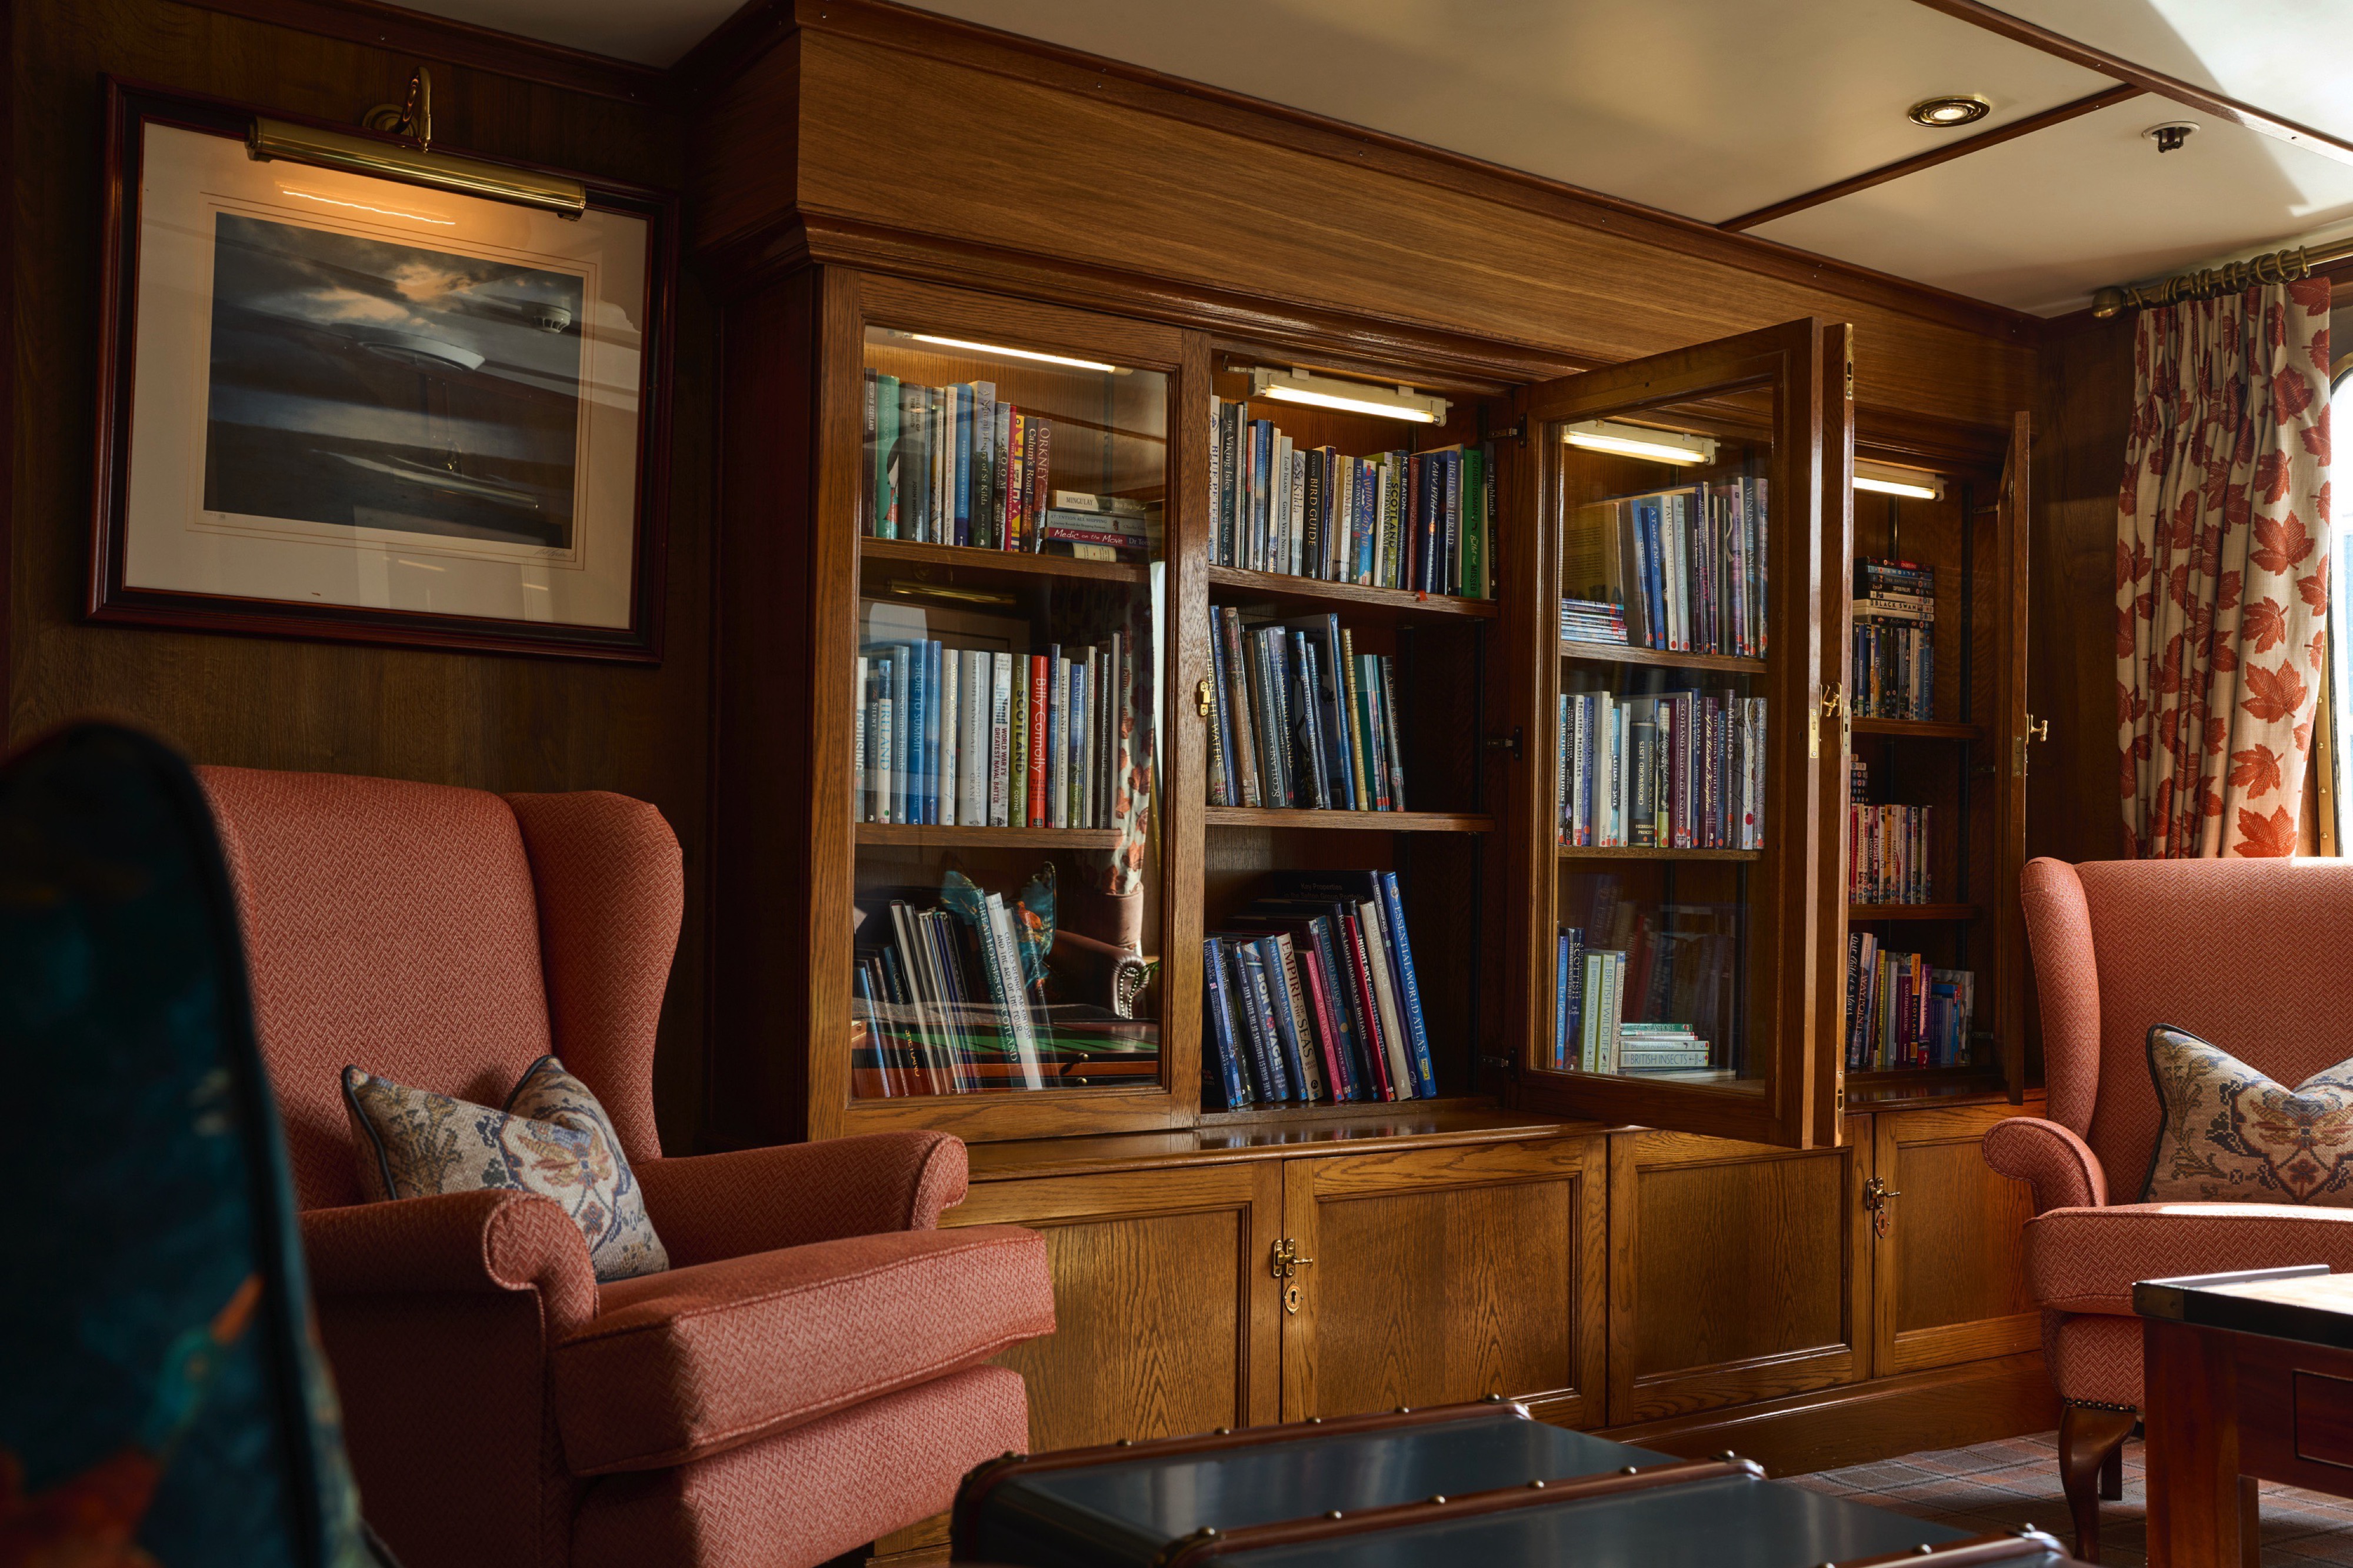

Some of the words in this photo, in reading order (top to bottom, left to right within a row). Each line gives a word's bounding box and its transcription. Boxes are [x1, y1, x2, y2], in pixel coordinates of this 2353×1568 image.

[1027, 428, 1036, 466] Calum's
[1037, 428, 1049, 481] ORKNEY
[1224, 435, 1234, 467] Viking
[1402, 456, 1408, 465] M.
[982, 463, 988, 472] of
[1026, 469, 1034, 494] Road
[1225, 471, 1233, 491] Isles
[1066, 496, 1093, 506] MINGULAY
[1293, 483, 1302, 513] Kilda
[1309, 478, 1318, 505] BIRD
[1344, 467, 1352, 518] COLUMBA
[1362, 479, 1373, 514] WHISKY
[1308, 509, 1318, 547] GUIDE
[1389, 483, 1399, 548] SCOTLAND
[1447, 509, 1455, 545] HERALD
[1054, 529, 1079, 539] Medic
[1101, 534, 1123, 545] Move
[1361, 516, 1371, 548] ISLAND
[1653, 541, 1658, 549] of
[1875, 600, 1897, 608] BLACK
[914, 662, 922, 693] SHORE
[1032, 678, 1046, 705] Billy
[914, 696, 922, 710] TO
[1349, 682, 1358, 709] ISLES
[856, 713, 864, 770] CRUISING
[880, 704, 891, 770] IRELAND
[913, 713, 922, 753] SUMMIT
[1031, 710, 1045, 773] Connolly
[996, 934, 1005, 949] AND
[1338, 914, 1347, 937] ROCK
[1371, 919, 1380, 946] SPIRIT
[1320, 922, 1328, 939] THE
[1324, 941, 1334, 972] ISLAND
[1329, 974, 1342, 1006] NATION
[1344, 939, 1358, 992] LIGHTHOUSES
[1358, 939, 1368, 965] NIGHT
[1364, 966, 1372, 982] SKY
[1376, 949, 1384, 961] OF
[1572, 942, 1580, 999] SCOTTISH
[978, 901, 990, 937] GREAT
[985, 940, 999, 983] HOUSES
[996, 986, 1004, 1000] OF
[1000, 1002, 1016, 1061] SCOTLAND
[1257, 973, 1269, 1003] BON
[1271, 946, 1279, 973] NEVER
[1275, 976, 1285, 999] TURN
[1282, 1000, 1291, 1023] BACK
[1281, 941, 1302, 1003] EMPIRE
[1379, 962, 1389, 989] PLACE
[1394, 906, 1409, 969] ESSENTIAL
[1405, 970, 1419, 1014] WORLD
[1412, 1016, 1426, 1053] ATLAS
[1604, 969, 1613, 1005] BRITISH
[893, 973, 904, 1005] Cleeves
[1354, 994, 1361, 1005] OF
[1300, 1005, 1305, 1014] OF
[1857, 975, 1868, 1036] WAYPOINTS
[1297, 1019, 1314, 1058] SEAS
[1318, 1002, 1332, 1050] MACBRAYNE
[1357, 1007, 1367, 1039] BRITAIN
[1601, 1008, 1611, 1053] WILDLIFE
[1631, 1054, 1657, 1065] BRITISH
[1659, 1054, 1687, 1065] INSECTS
